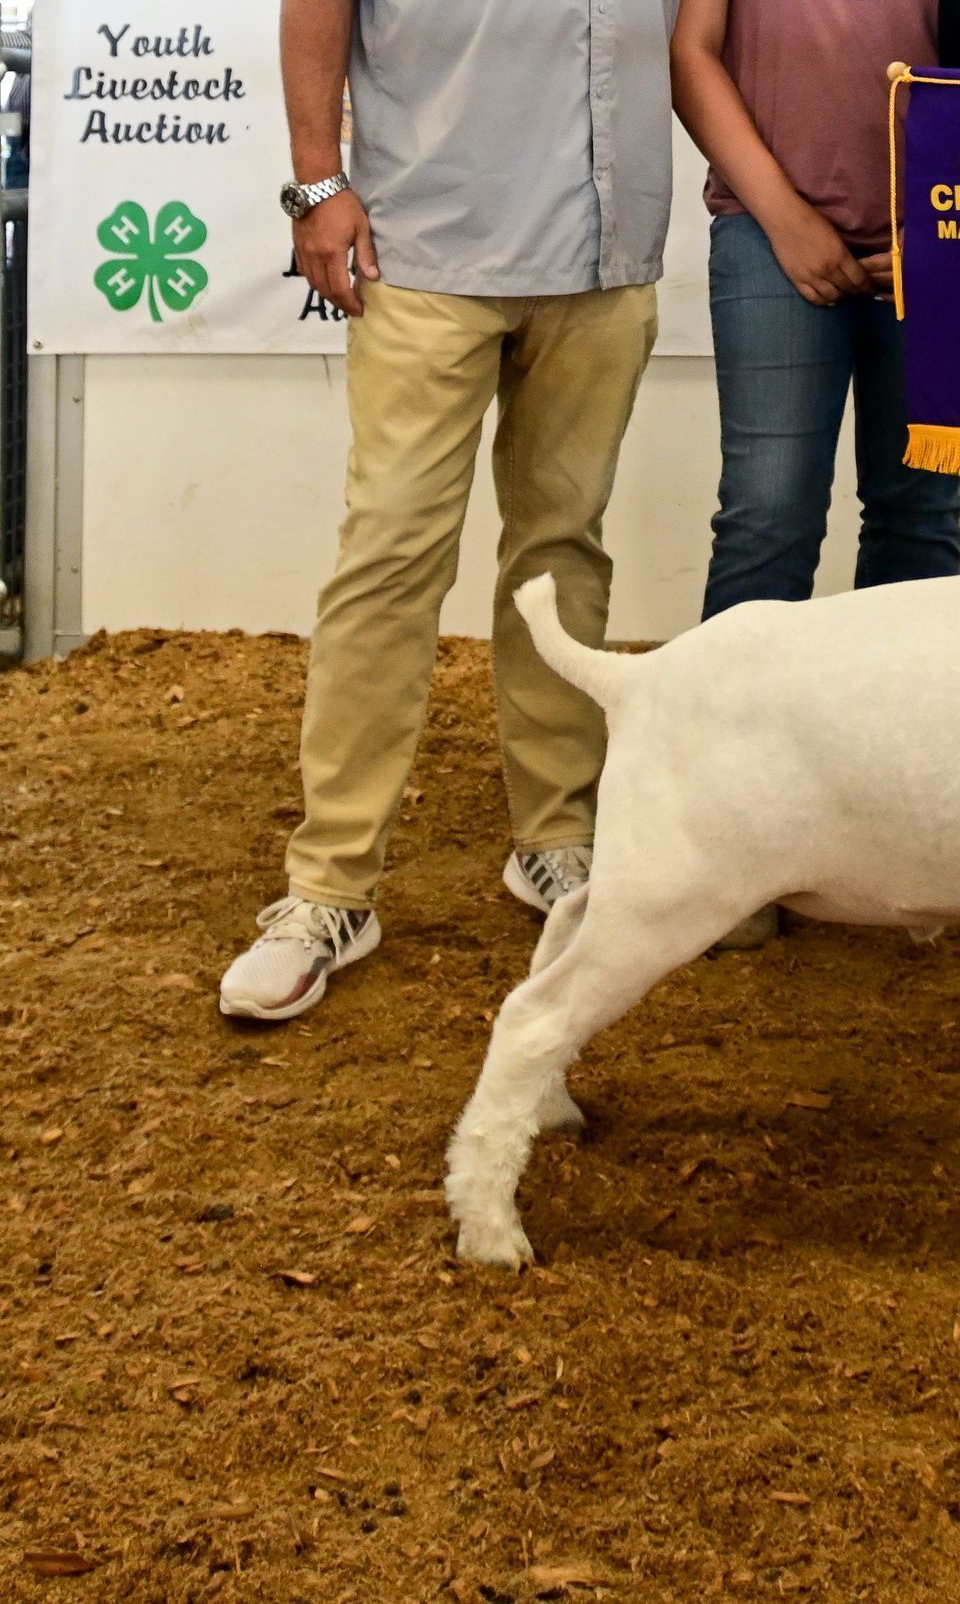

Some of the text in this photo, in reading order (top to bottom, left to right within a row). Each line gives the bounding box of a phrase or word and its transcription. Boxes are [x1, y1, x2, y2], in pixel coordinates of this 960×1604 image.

[98, 23, 214, 57] Youth
[63, 66, 246, 101] Livestock
[79, 109, 230, 144] Auction
[111, 215, 193, 245] H H
[107, 267, 196, 296] H H
